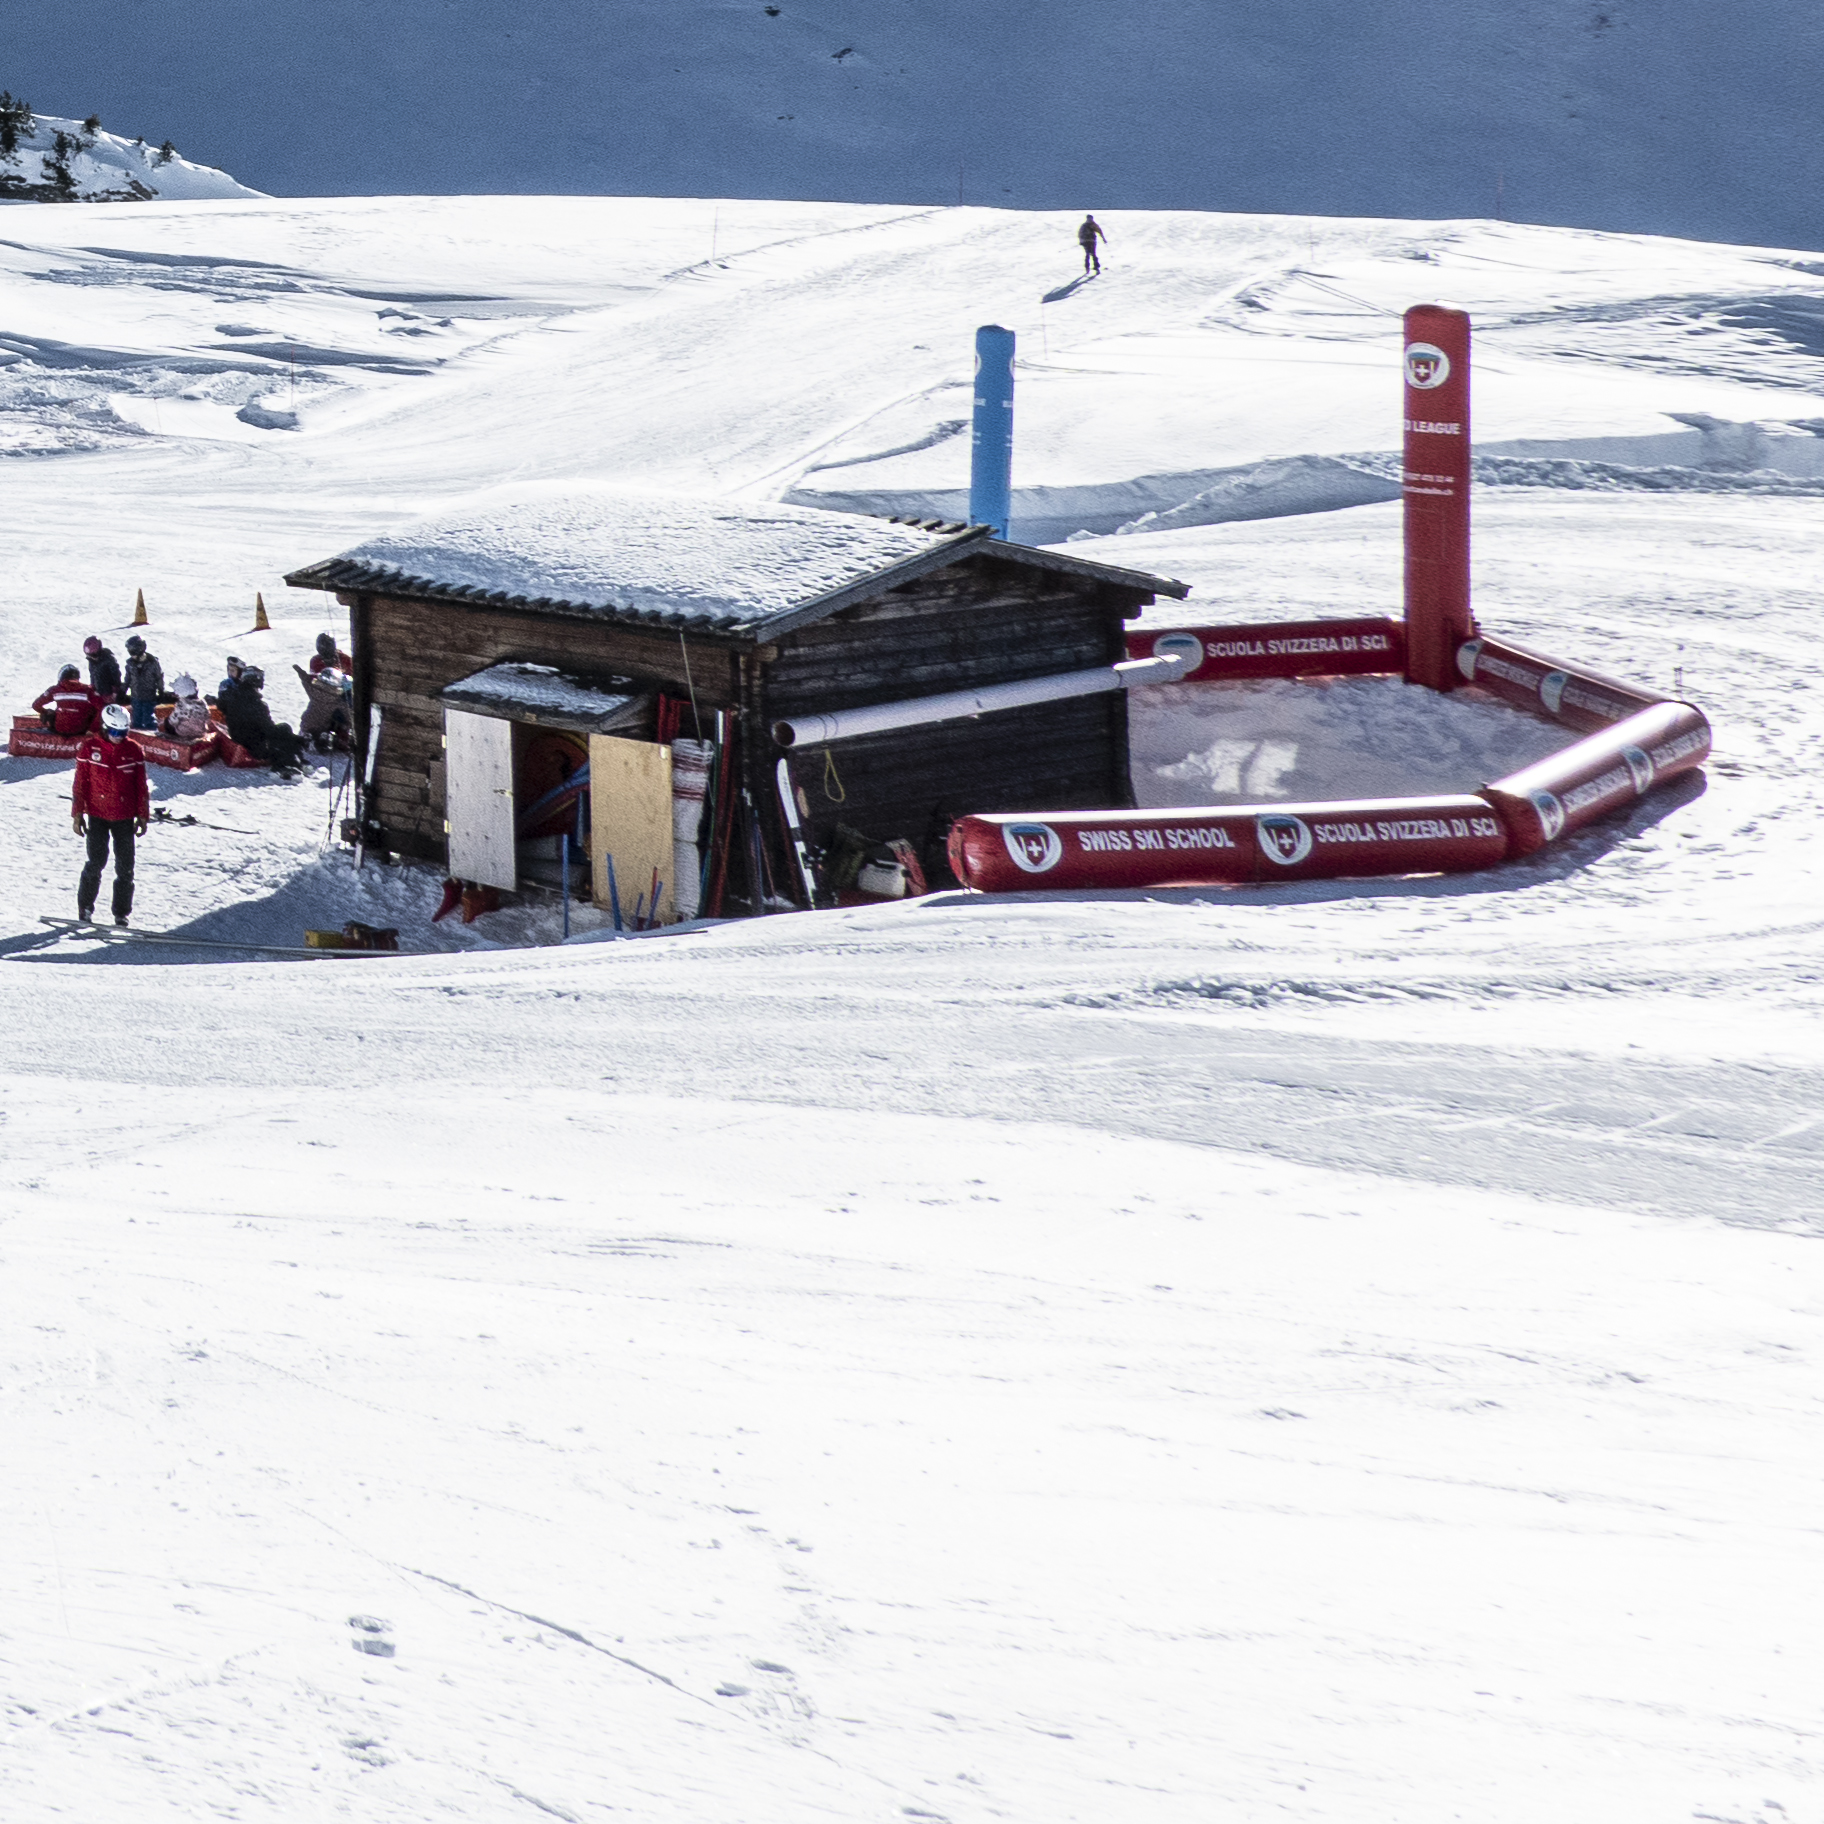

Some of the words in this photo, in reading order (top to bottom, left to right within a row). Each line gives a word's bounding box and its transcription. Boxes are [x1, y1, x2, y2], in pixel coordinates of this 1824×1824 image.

[1412, 420, 1461, 435] LEAGUE
[1206, 640, 1265, 658] SCUOLA
[1268, 636, 1339, 655] SVIZZERA
[1341, 635, 1357, 651] DI
[1360, 633, 1389, 651] SCI
[1077, 829, 1133, 852] SWISS
[1132, 828, 1165, 850] SKI
[1164, 827, 1235, 850] SCHOOL
[1314, 822, 1377, 844] SCUOLA
[1376, 819, 1453, 842] SVIZZERA
[1451, 818, 1470, 838] DI
[1470, 817, 1500, 837] SCI
